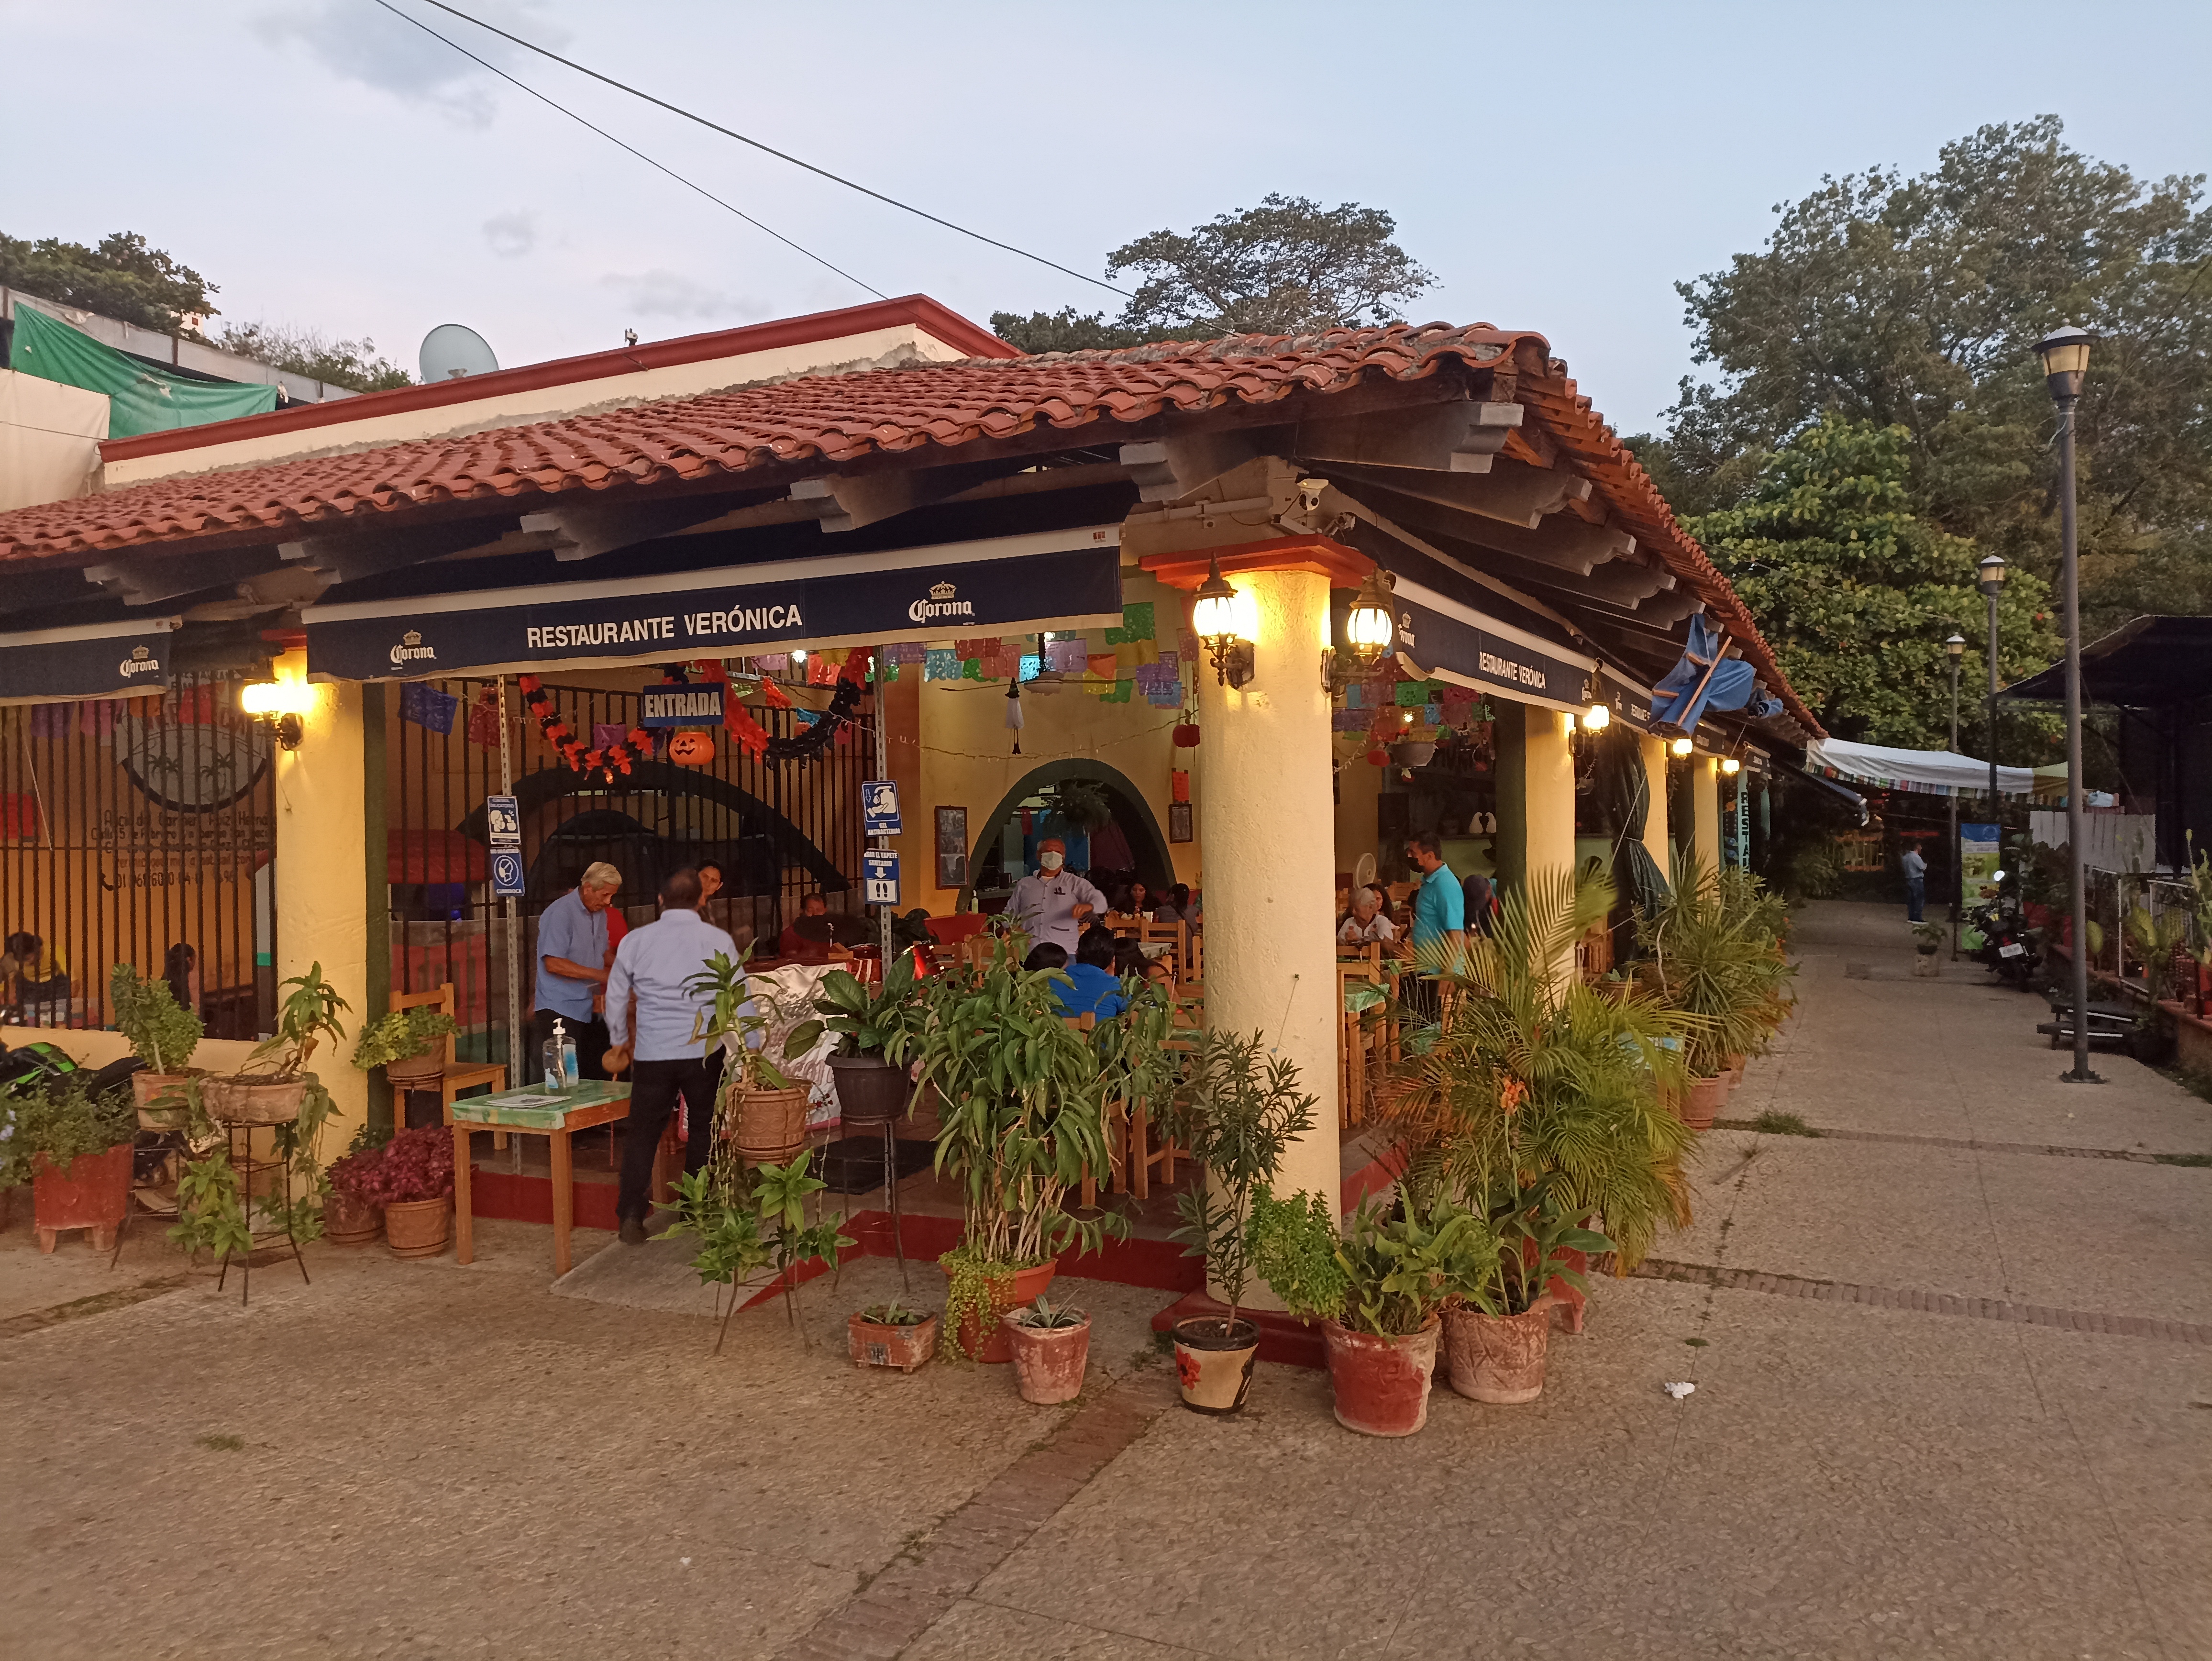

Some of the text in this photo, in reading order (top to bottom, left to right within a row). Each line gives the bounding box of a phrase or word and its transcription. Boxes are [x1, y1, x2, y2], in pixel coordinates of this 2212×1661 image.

[909, 599, 972, 623] Corona
[527, 605, 803, 648] RESTAURANTE VERÓNICA
[390, 644, 435, 665] Corona
[120, 659, 159, 678] Corona
[1479, 651, 1546, 689] RESTAURANTE VERÓNICA
[645, 692, 721, 718] ENTRADA
